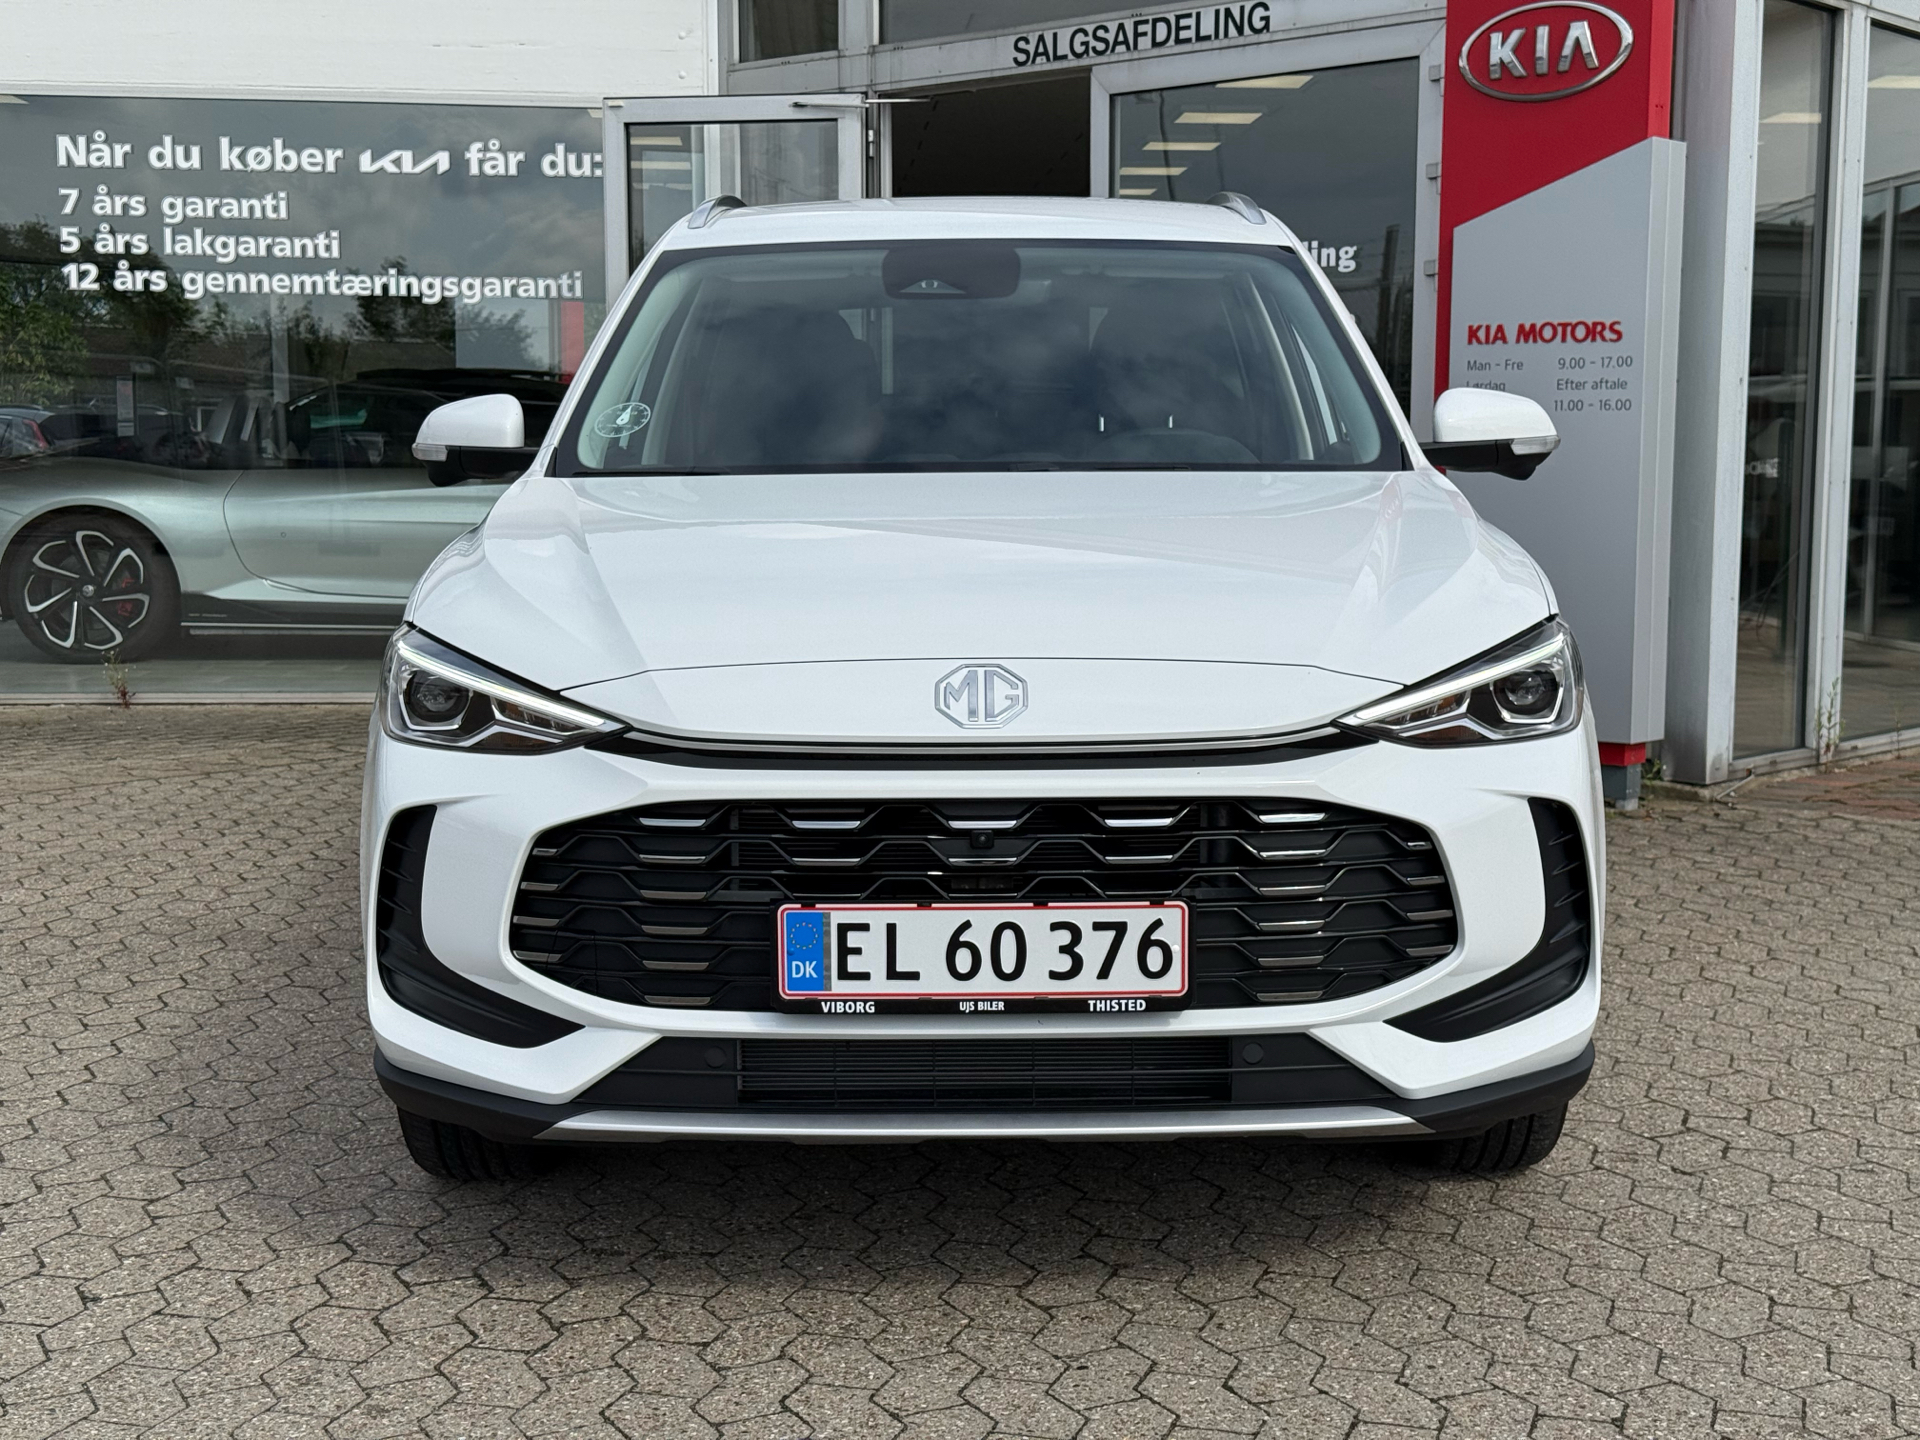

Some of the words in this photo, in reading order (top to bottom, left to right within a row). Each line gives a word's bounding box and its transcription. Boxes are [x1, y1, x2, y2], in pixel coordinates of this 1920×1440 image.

[1013, 1, 1270, 67] SALGSAFDELING
[1489, 19, 1599, 80] KIA
[56, 130, 131, 167] Når
[148, 135, 201, 169] du
[219, 137, 344, 173] køber
[465, 138, 525, 177] får
[542, 144, 602, 178] du:
[58, 188, 78, 214] 7
[93, 184, 146, 217] års
[161, 191, 287, 224] garanti
[60, 227, 80, 253] 5
[95, 224, 148, 254] års
[163, 227, 340, 263] lakgaranti
[61, 264, 98, 290] 12
[114, 260, 167, 291] års
[182, 268, 583, 303] gennemtæringsgaranti
[1467, 324, 1508, 345] KIA
[1515, 321, 1623, 343] MOTORS
[1466, 360, 1491, 371] Man
[1504, 358, 1524, 371] Fre
[1557, 357, 1586, 370] 9.00
[1601, 356, 1633, 369] 17.00
[1556, 378, 1588, 391] Efter
[1591, 377, 1628, 390] aftale
[1554, 399, 1584, 412] 11.00
[1599, 398, 1632, 411] 16.00
[943, 669, 1020, 722] MG
[837, 923, 920, 981] EL
[945, 919, 1027, 982] 60
[1048, 917, 1173, 981] 376
[791, 960, 818, 978] DK
[821, 1001, 876, 1014] VIBORG
[959, 1001, 975, 1013] UJS
[977, 1001, 1005, 1011] BILER
[1088, 999, 1147, 1012] THISTED
